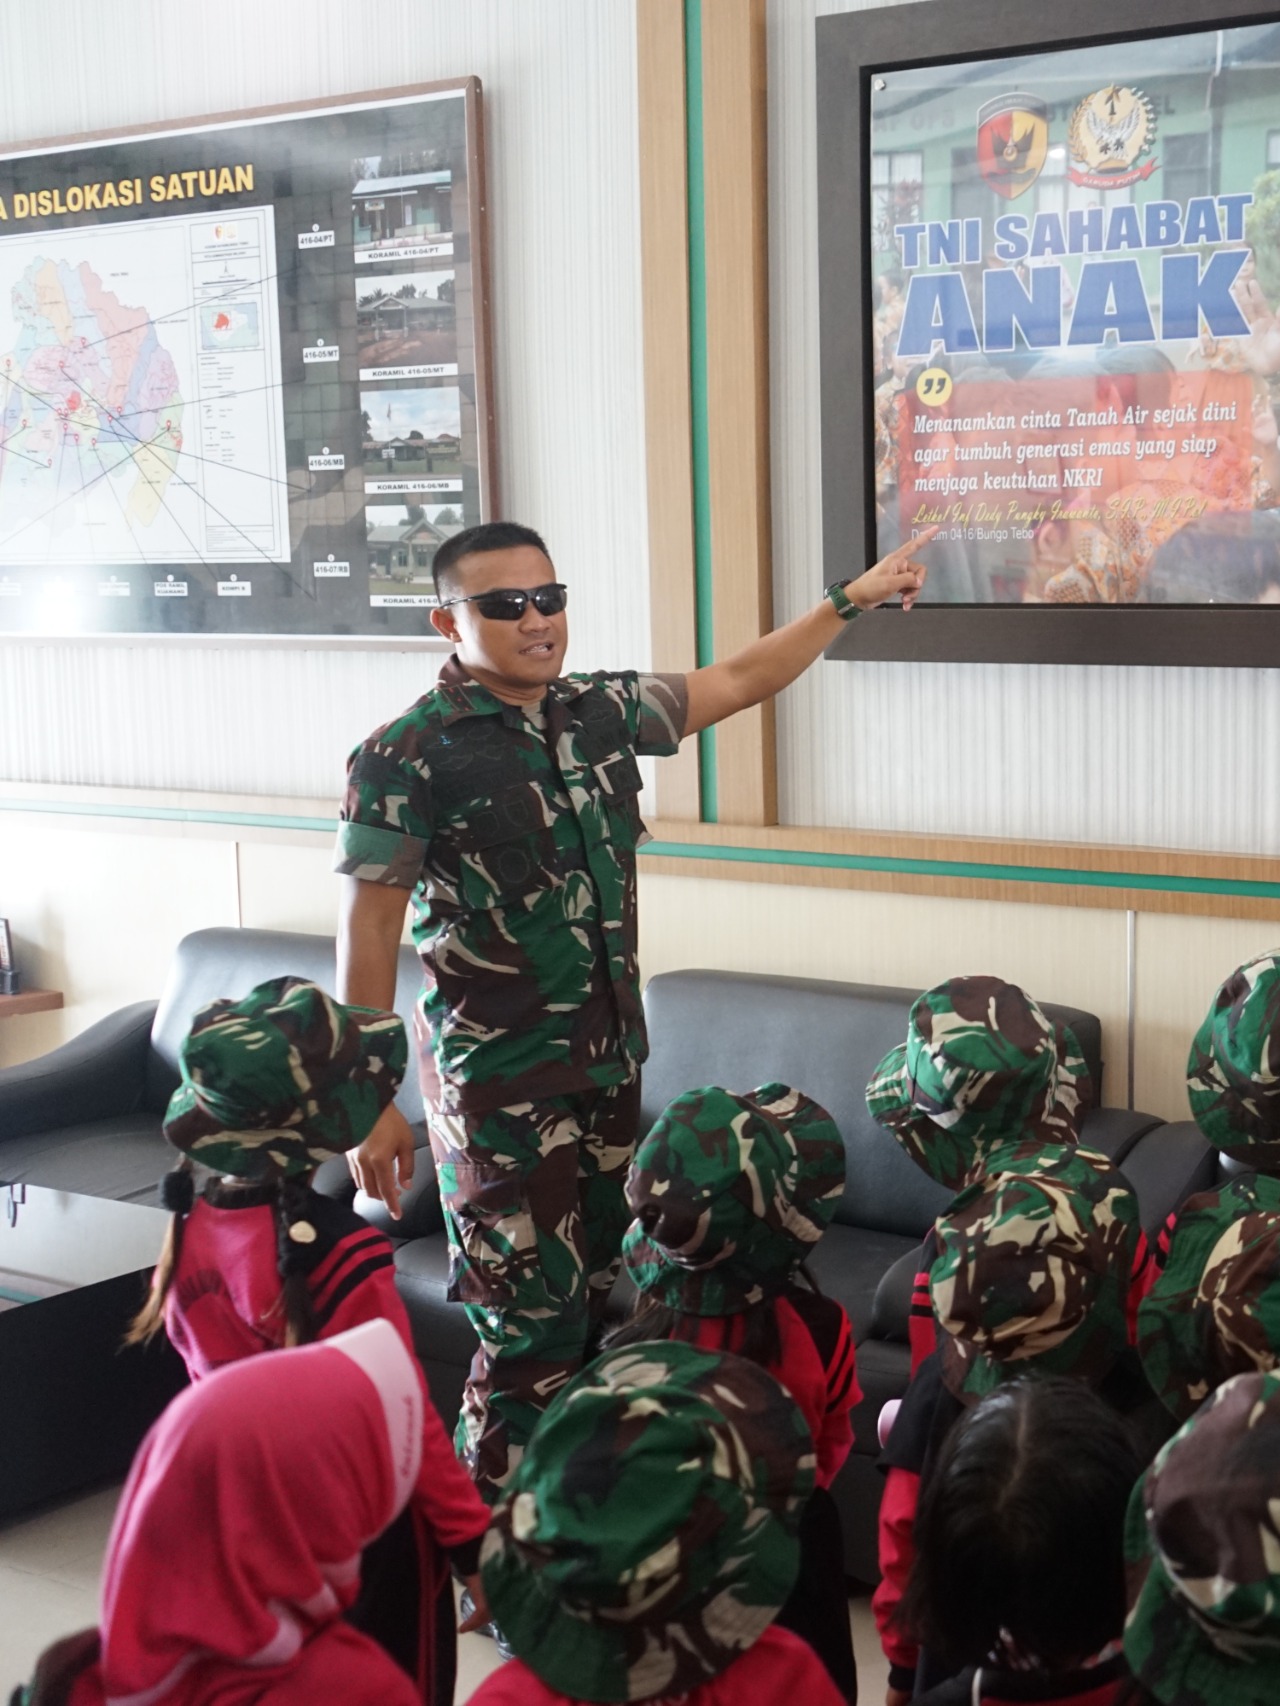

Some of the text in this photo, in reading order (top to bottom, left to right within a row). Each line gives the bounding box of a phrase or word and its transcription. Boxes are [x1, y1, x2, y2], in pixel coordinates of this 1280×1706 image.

[13, 178, 142, 219] DISLOKASI
[150, 164, 254, 202] SATUAN
[895, 192, 1253, 269] TNI SAHABAT
[367, 251, 402, 260] KORAMIL
[896, 248, 1252, 357] ANAK
[372, 369, 406, 378] KORAMIL
[913, 402, 1238, 434] Menanamkan cinta Tanah Air sejak dini
[914, 434, 1217, 468] agar tumbuh generasi emas yang siap
[914, 468, 1104, 496] menjaga keutuhan NKRI
[951, 527, 1008, 543] 0416/Bungo
[1011, 526, 1034, 540] Tebo
